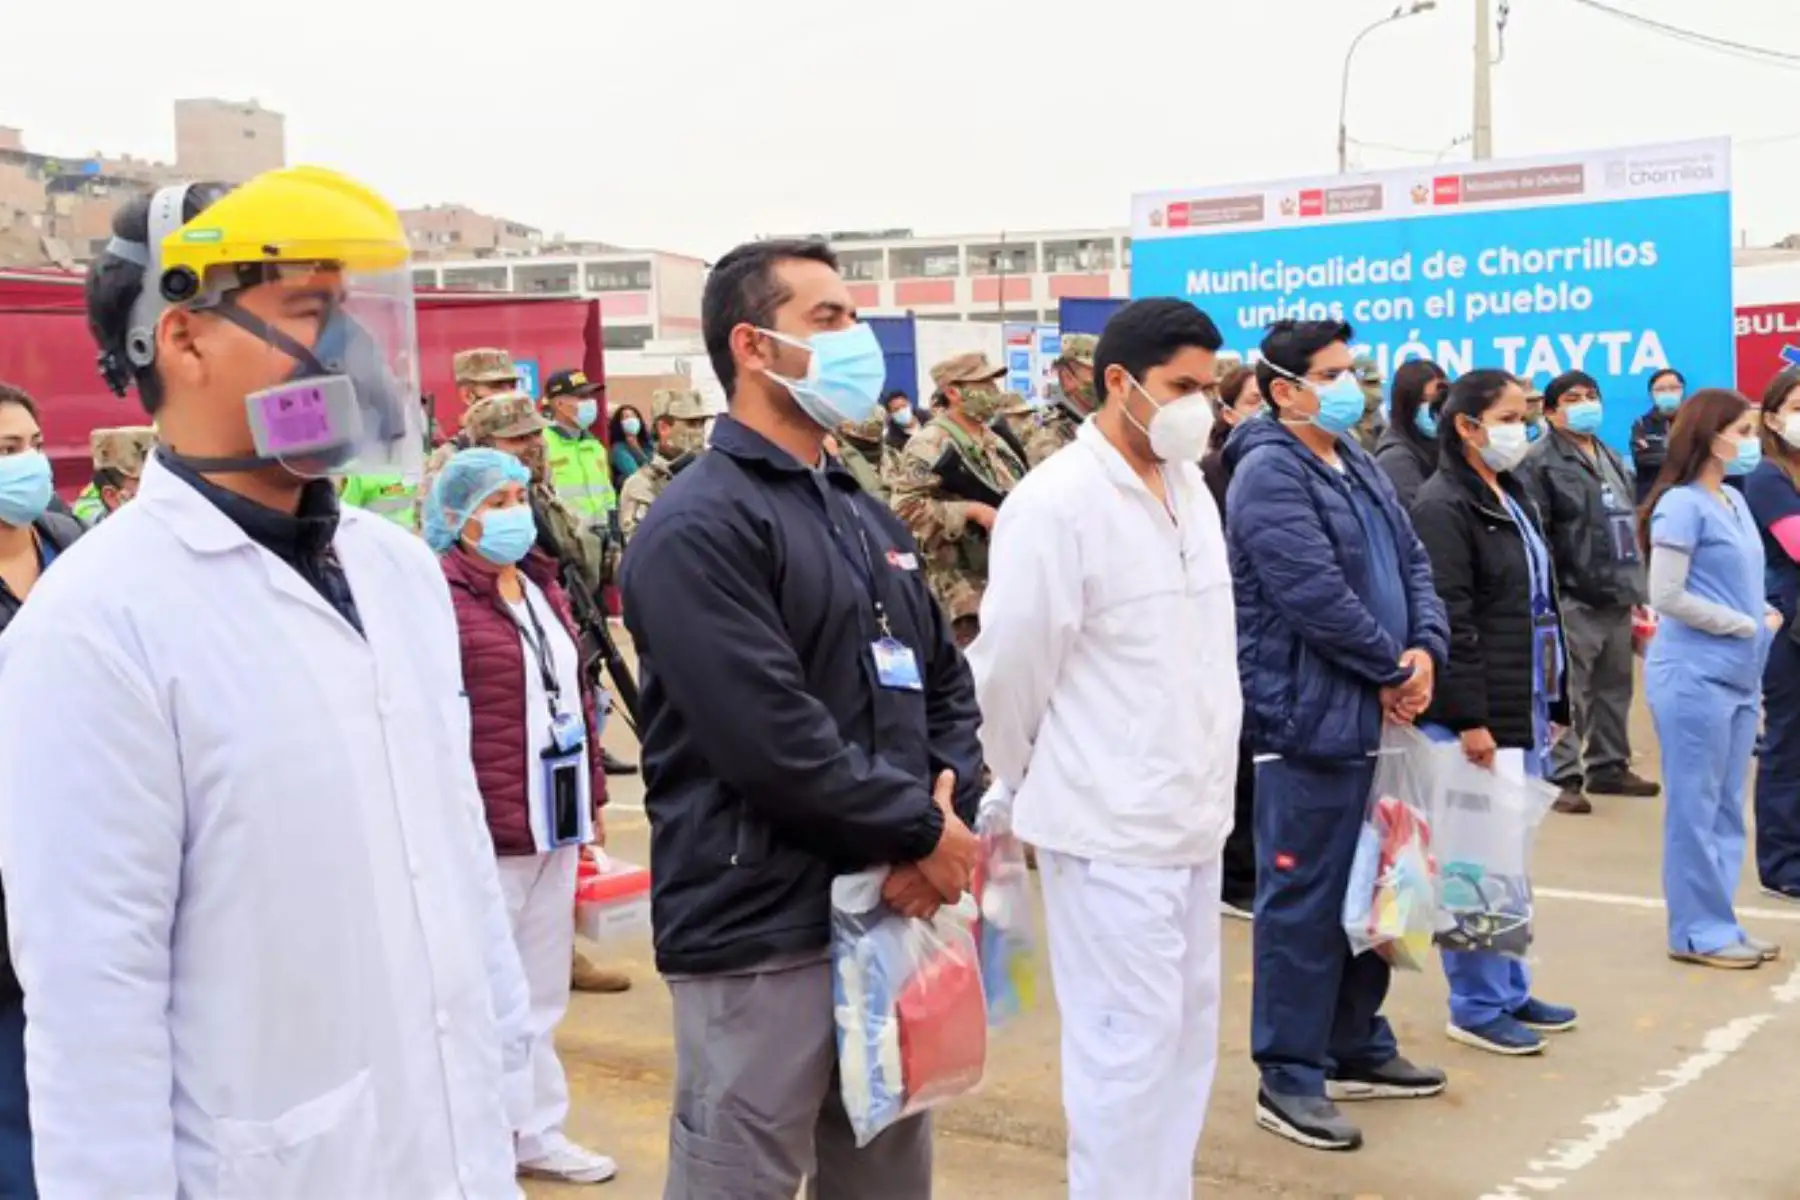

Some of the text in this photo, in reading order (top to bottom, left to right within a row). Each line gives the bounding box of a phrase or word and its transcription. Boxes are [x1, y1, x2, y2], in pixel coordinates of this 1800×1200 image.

[1187, 237, 1658, 295] Municipalidad de Chorrillos
[1238, 281, 1593, 329] unidos con el pueblo
[1736, 312, 1800, 336] BUL
[1493, 329, 1671, 380] TAYTA
